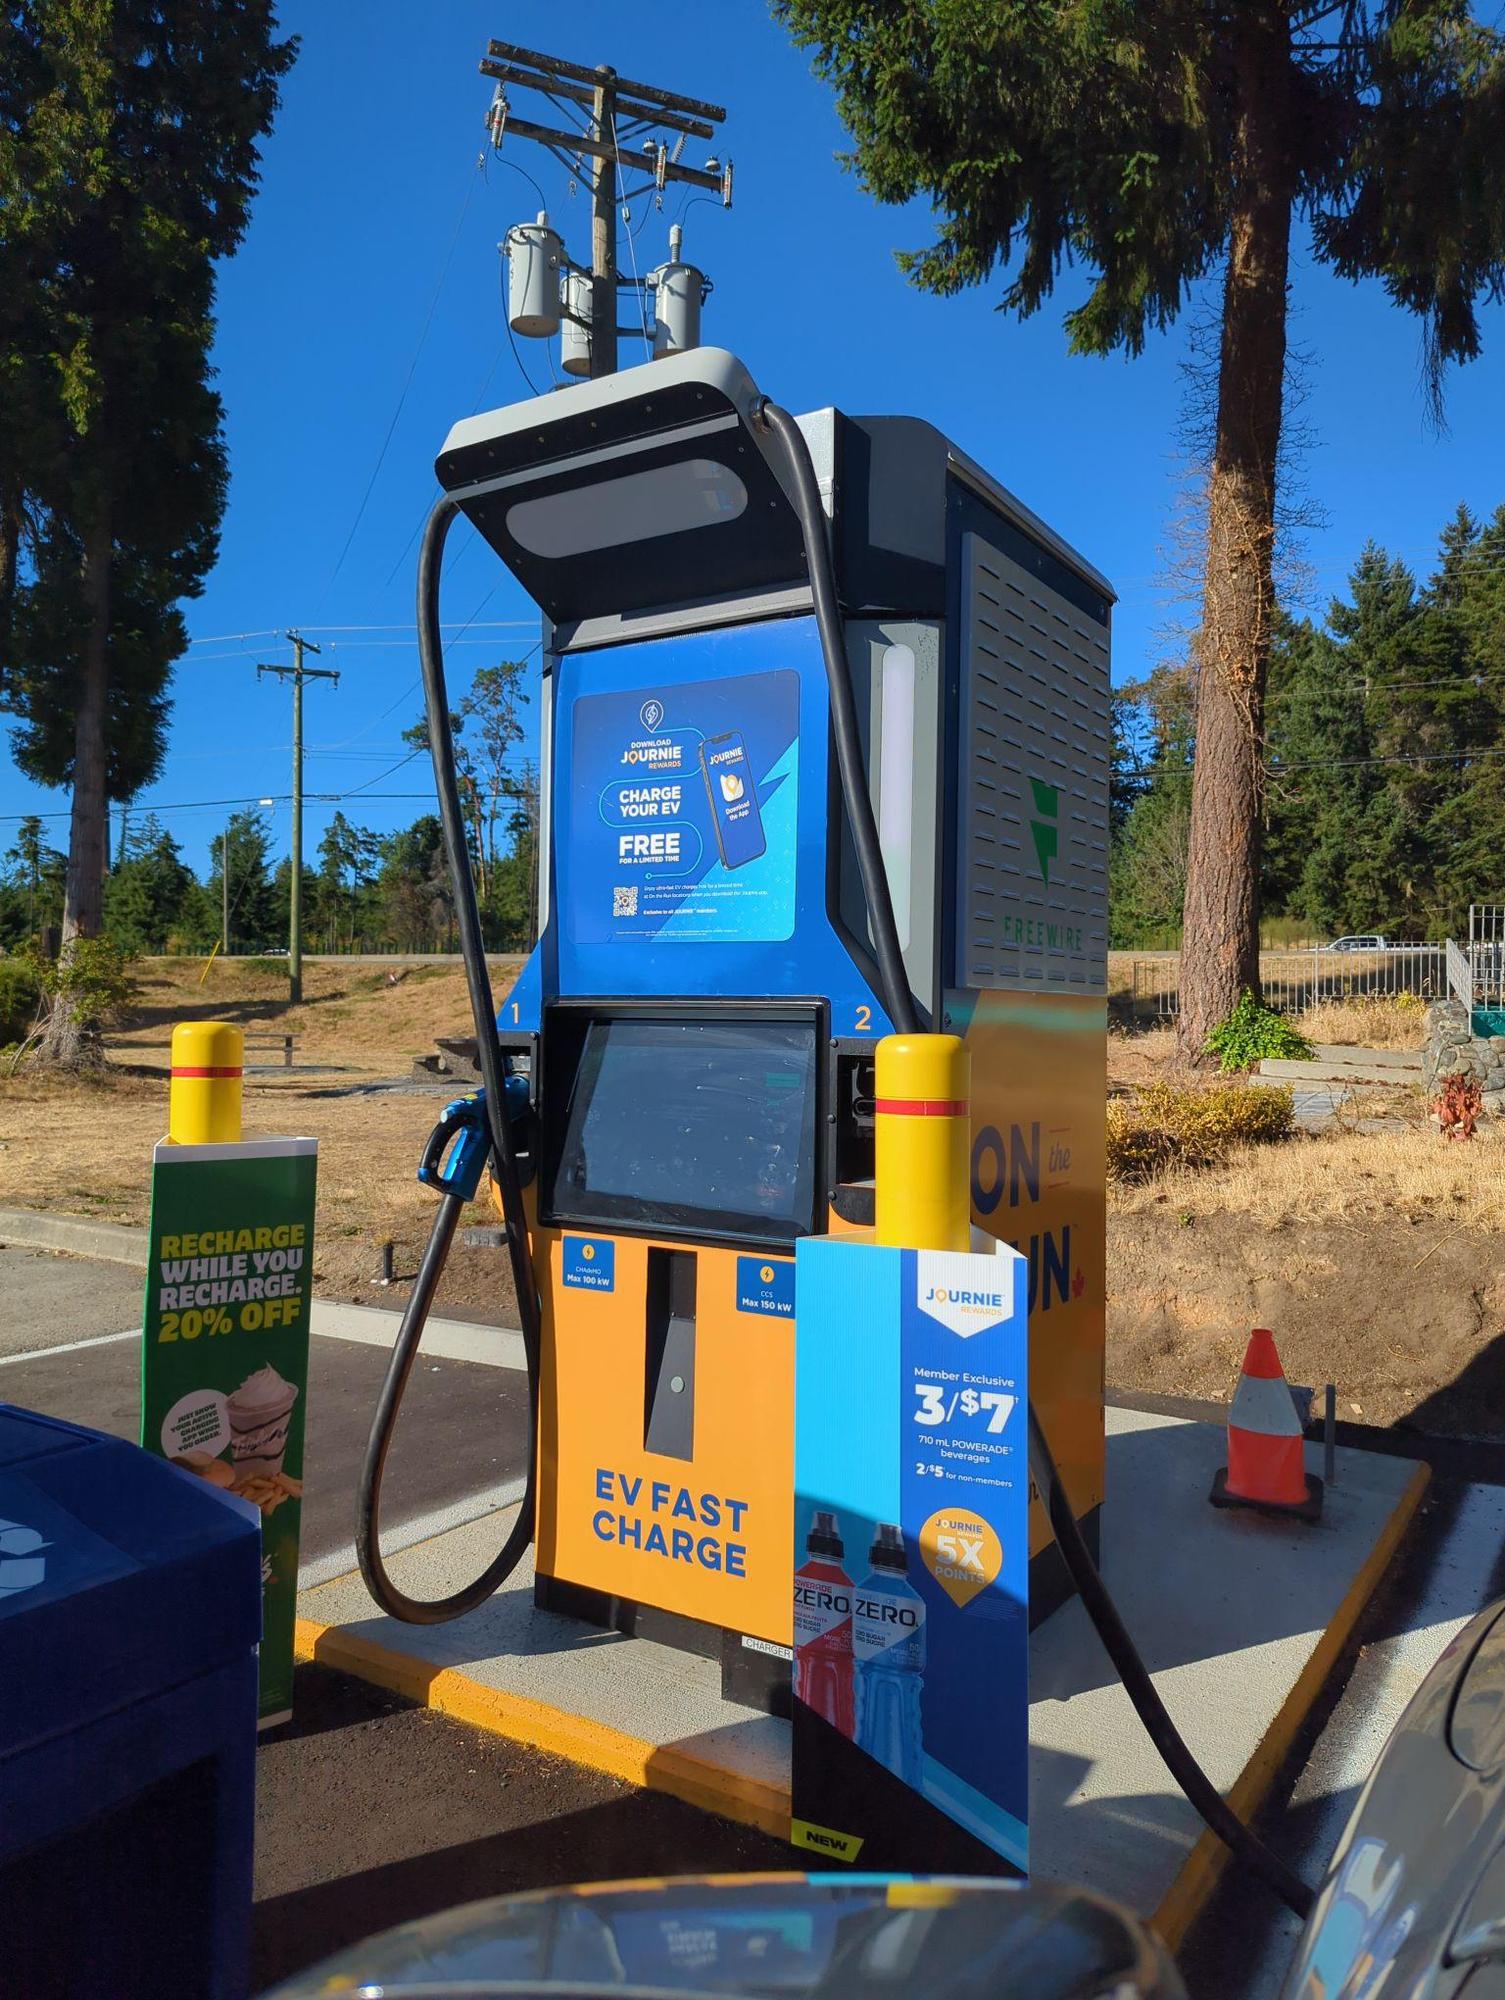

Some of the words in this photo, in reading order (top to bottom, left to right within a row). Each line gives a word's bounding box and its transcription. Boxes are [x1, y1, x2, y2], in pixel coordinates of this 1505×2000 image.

[631, 739, 672, 748] DOWNLOAD
[620, 746, 682, 765] JOURNIE
[709, 747, 743, 765] JOURNIE
[648, 761, 682, 769] REWARDS
[619, 786, 682, 803] CHARGE
[620, 803, 658, 817] YOUR
[661, 801, 680, 815] EV
[725, 800, 750, 815] Download
[729, 813, 738, 821] the
[739, 809, 750, 818] App
[619, 833, 680, 856] FREE
[1004, 916, 1082, 950] FREEWIRE
[511, 1002, 519, 1024] 1
[855, 1005, 871, 1030] 2
[970, 1121, 1040, 1215] ON
[1049, 1140, 1070, 1173] the
[161, 1224, 305, 1258] RECHARGE
[161, 1254, 248, 1284] WHILE
[252, 1248, 304, 1273] YOU
[567, 1274, 581, 1283] Max
[583, 1276, 596, 1285] 100
[597, 1278, 610, 1287] kW
[159, 1273, 302, 1311] RECHARGE.
[760, 1290, 773, 1298] CCS
[926, 1288, 1003, 1307] JOURNIE
[742, 1298, 759, 1308] Max
[761, 1300, 775, 1310] 150
[777, 1302, 792, 1312] kW
[961, 1306, 1002, 1316] REWARDS
[158, 1307, 233, 1343] 20%
[240, 1298, 302, 1331] OFF
[914, 1367, 960, 1382] Member
[963, 1372, 1015, 1388] Exclusive
[178, 1442, 193, 1452] YOU
[918, 1435, 933, 1444] 710
[936, 1438, 950, 1447] mL
[940, 1448, 991, 1464] beverages
[958, 1475, 1013, 1488] non-members
[596, 1468, 643, 1506] EV
[652, 1481, 749, 1533] FAST
[935, 1519, 983, 1533] JOURNIE
[593, 1510, 747, 1578] CHARGE
[936, 1535, 985, 1571] 5X
[935, 1566, 985, 1584] POINTS
[746, 1638, 791, 1659] CHARGER
[806, 1830, 848, 1853] NEW
